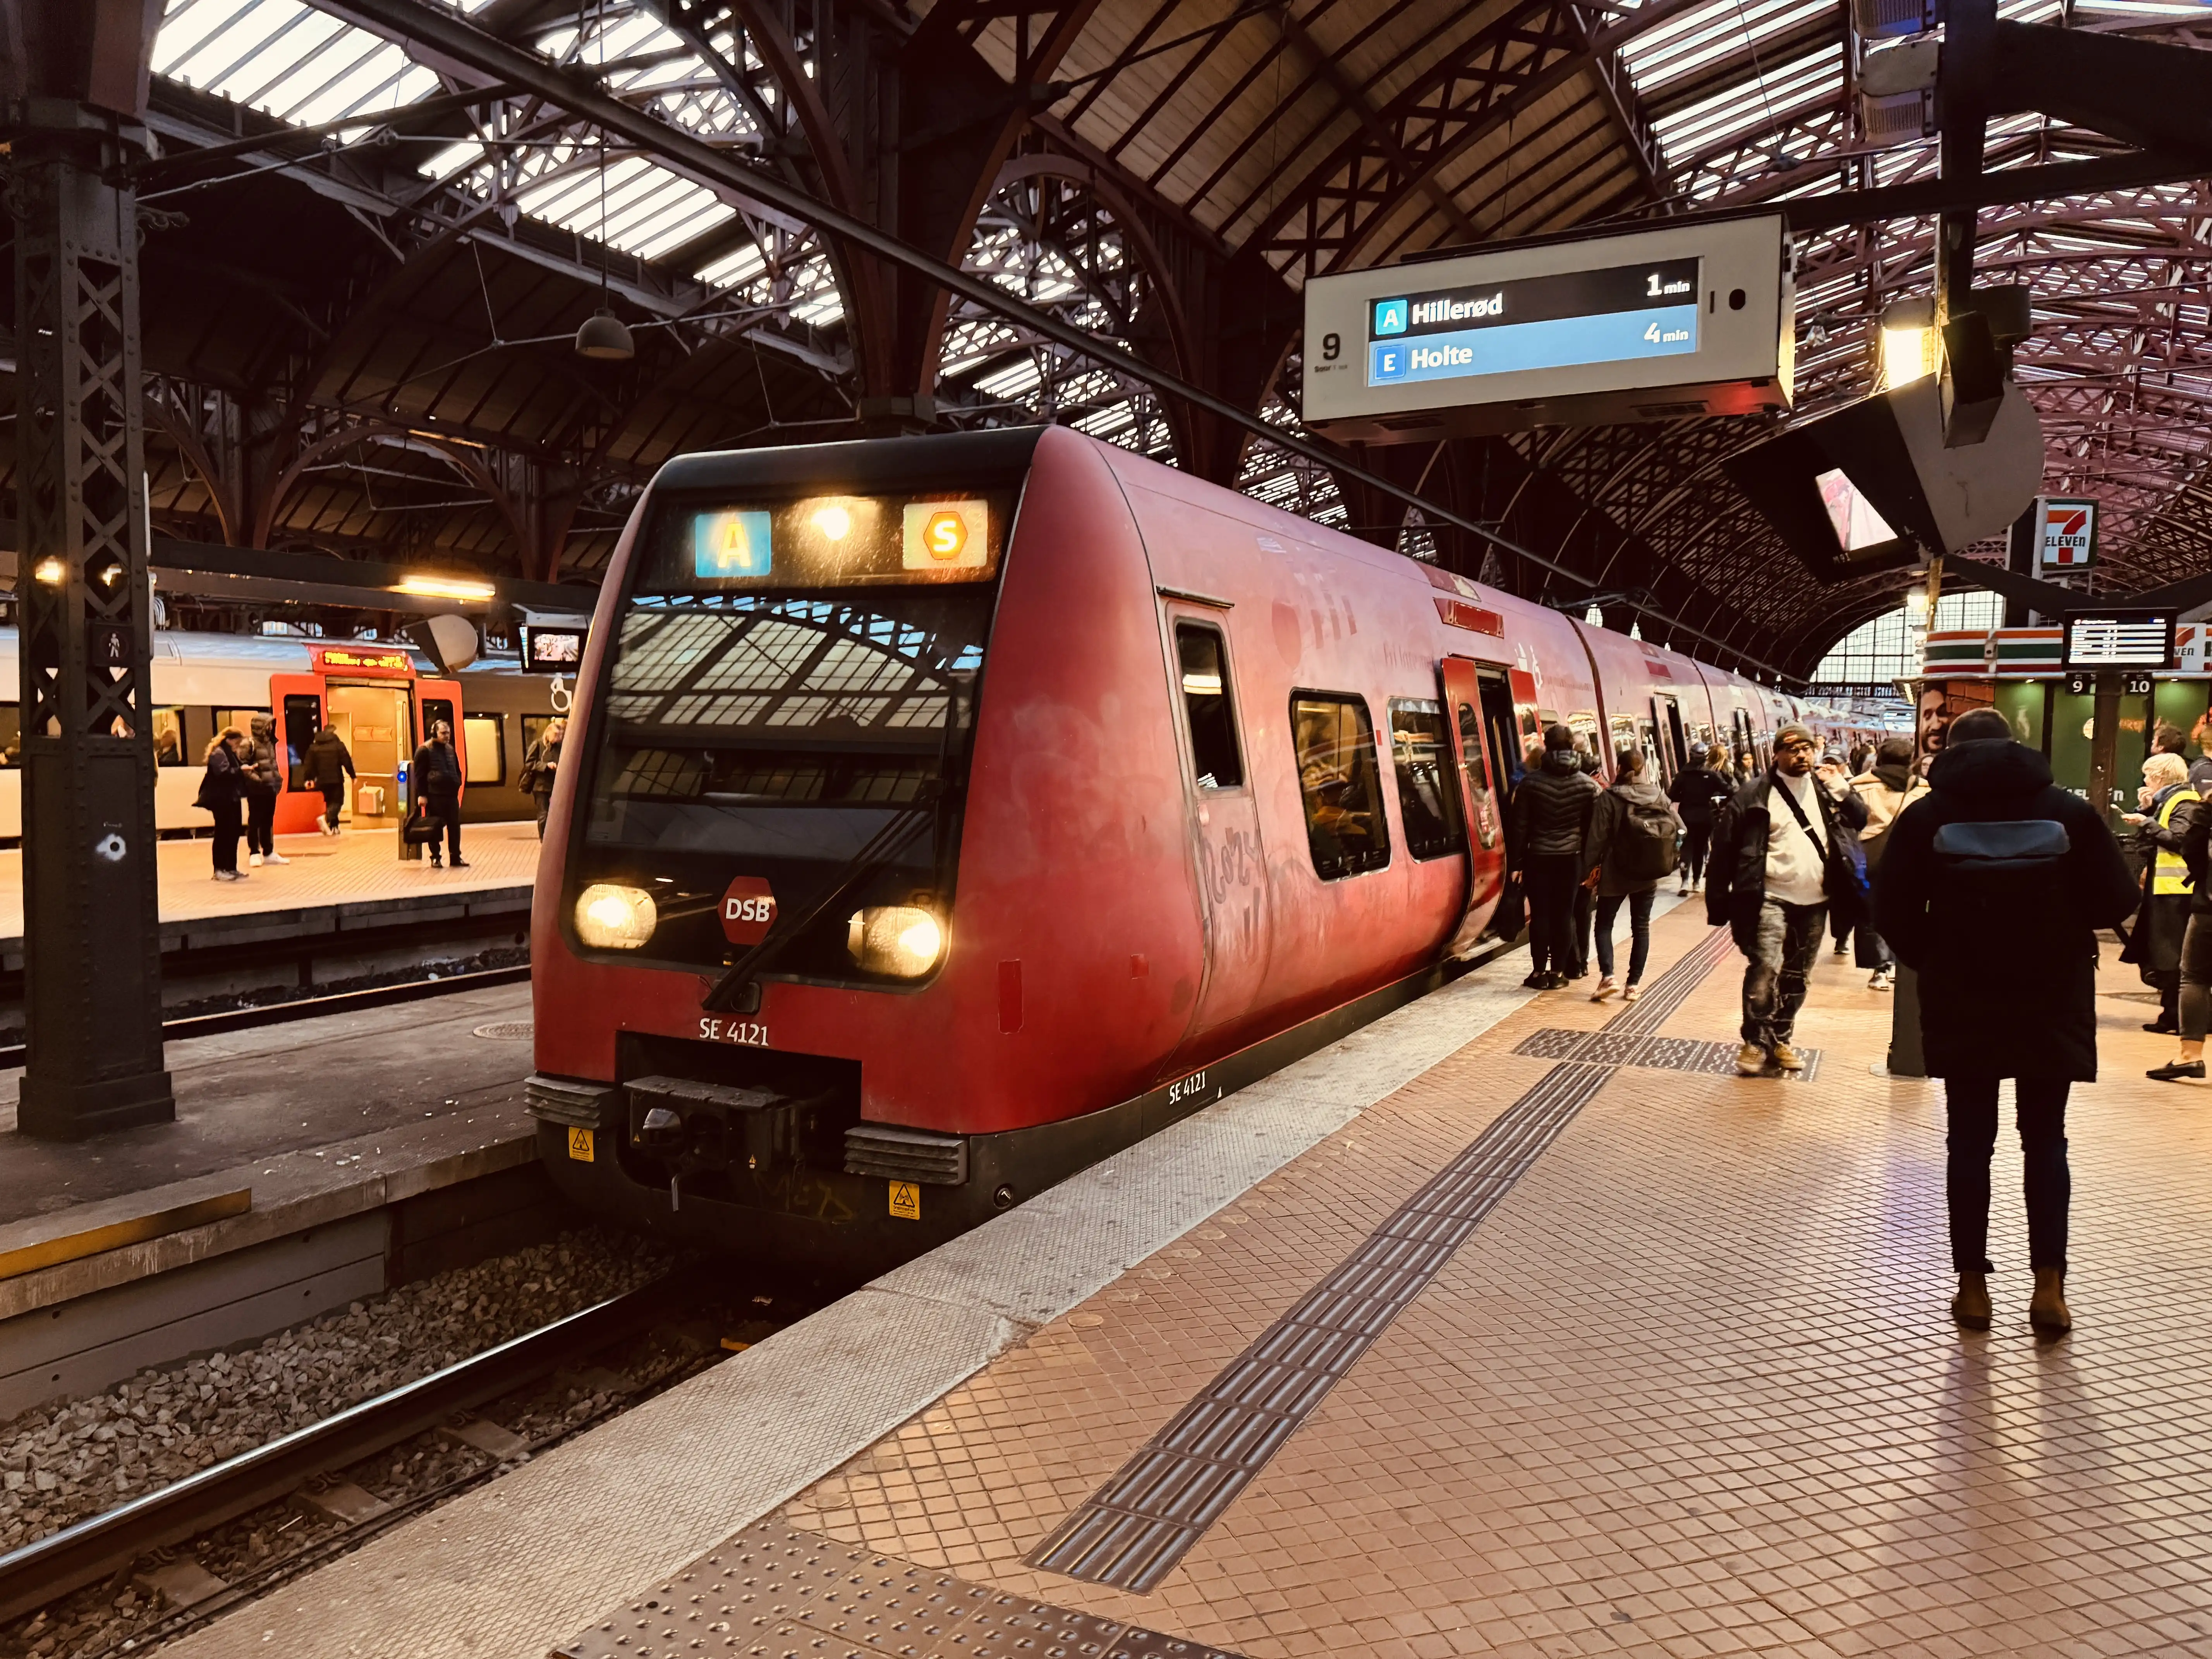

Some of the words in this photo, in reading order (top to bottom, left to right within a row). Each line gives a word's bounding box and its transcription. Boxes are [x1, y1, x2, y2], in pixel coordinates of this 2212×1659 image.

[1383, 309, 1399, 327] A
[1412, 293, 1503, 325] Hillerød
[1647, 274, 1662, 296] 1
[1664, 281, 1690, 295] min
[1322, 333, 1340, 360] 9
[1384, 353, 1396, 372] E
[1411, 345, 1473, 369] Holte
[1644, 322, 1661, 343] 4
[1662, 329, 1689, 342] min
[718, 522, 751, 568] A
[933, 520, 958, 552] S
[2072, 680, 2083, 693] 9
[2130, 680, 2150, 693] 10
[725, 898, 770, 922] DSB
[699, 1018, 723, 1040] SE
[726, 1022, 769, 1046] 4121
[1169, 1081, 1182, 1105] SE
[1183, 1070, 1206, 1096] 4121
